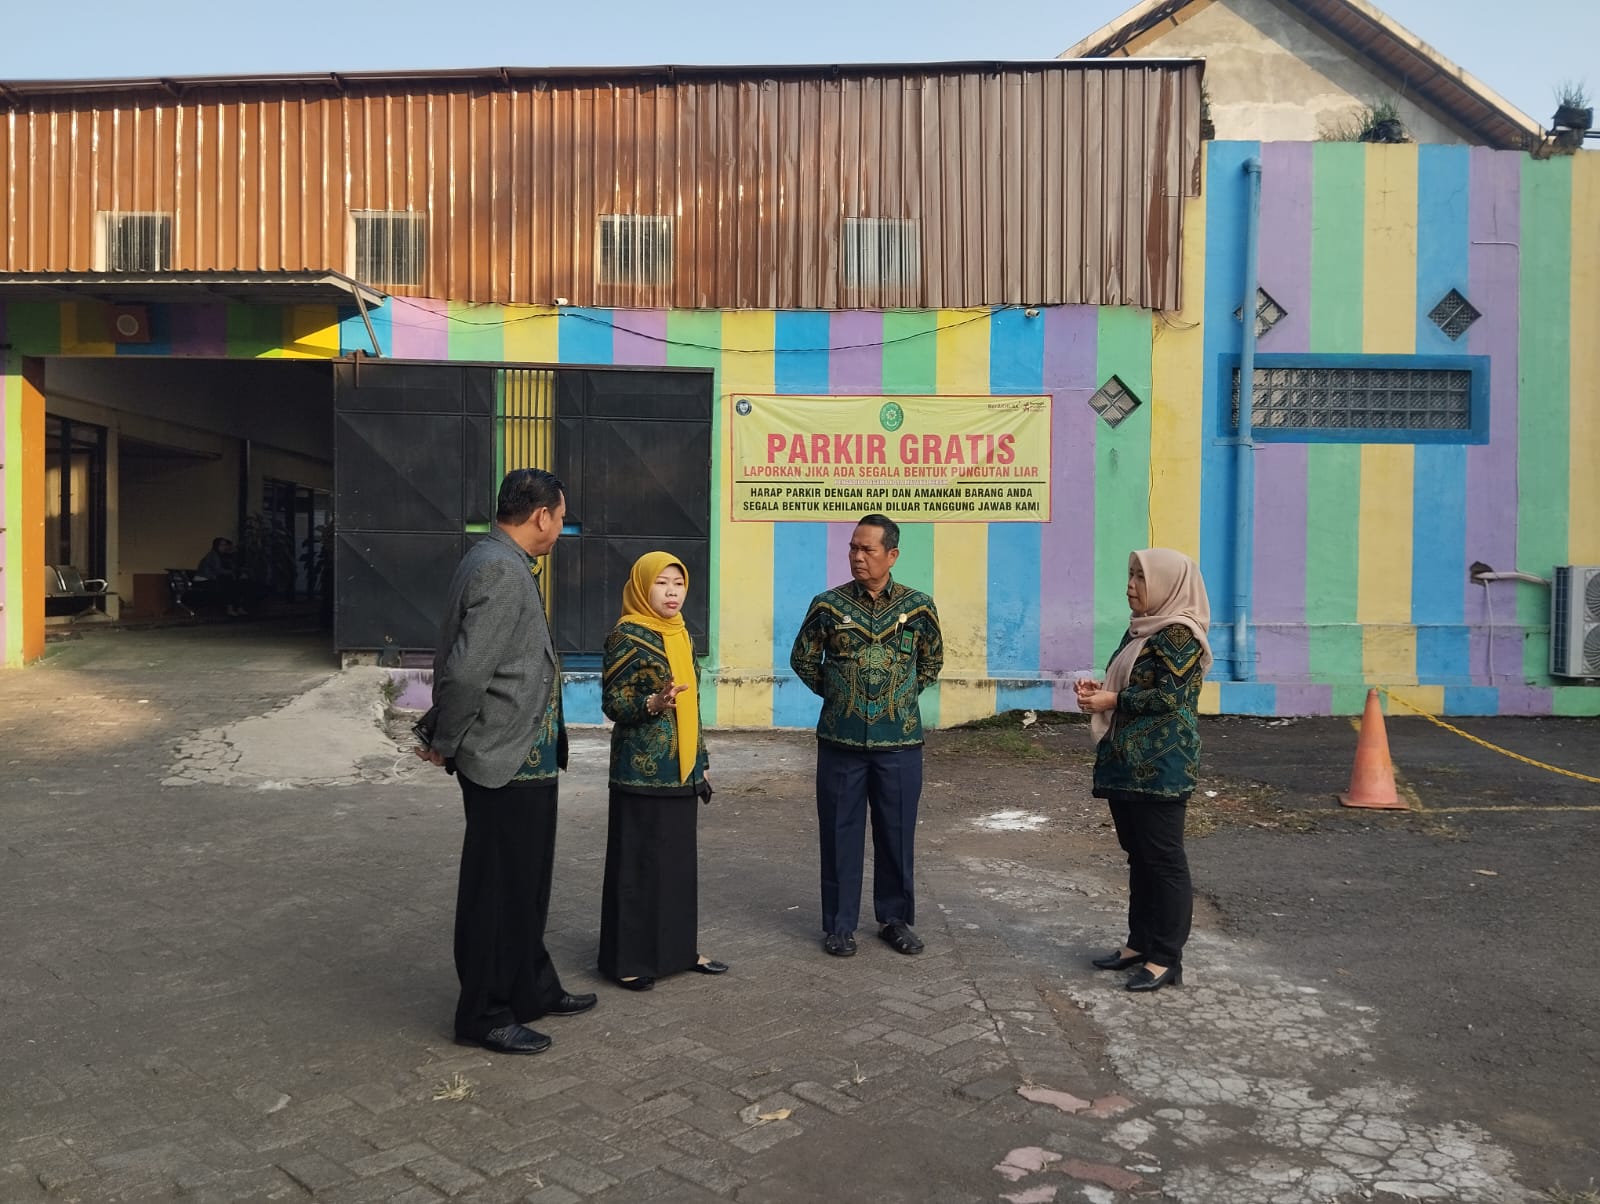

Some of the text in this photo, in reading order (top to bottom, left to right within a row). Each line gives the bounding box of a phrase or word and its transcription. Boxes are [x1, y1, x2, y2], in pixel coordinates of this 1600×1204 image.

[767, 433, 1016, 465] PARKIR GRATIS
[743, 466, 1038, 478] LAPORKAN JIKA ADA SEGALA BENTUK PUNGUTAN LIAR
[750, 487, 1032, 498] HARAP PARKIR DENGAN RAPI DAN AMANKAN BARANG ANDA
[743, 501, 1040, 512] SEGALA BENTUK KEHILANGAN DILUAR TANGGUNG JAWAB KAMI
